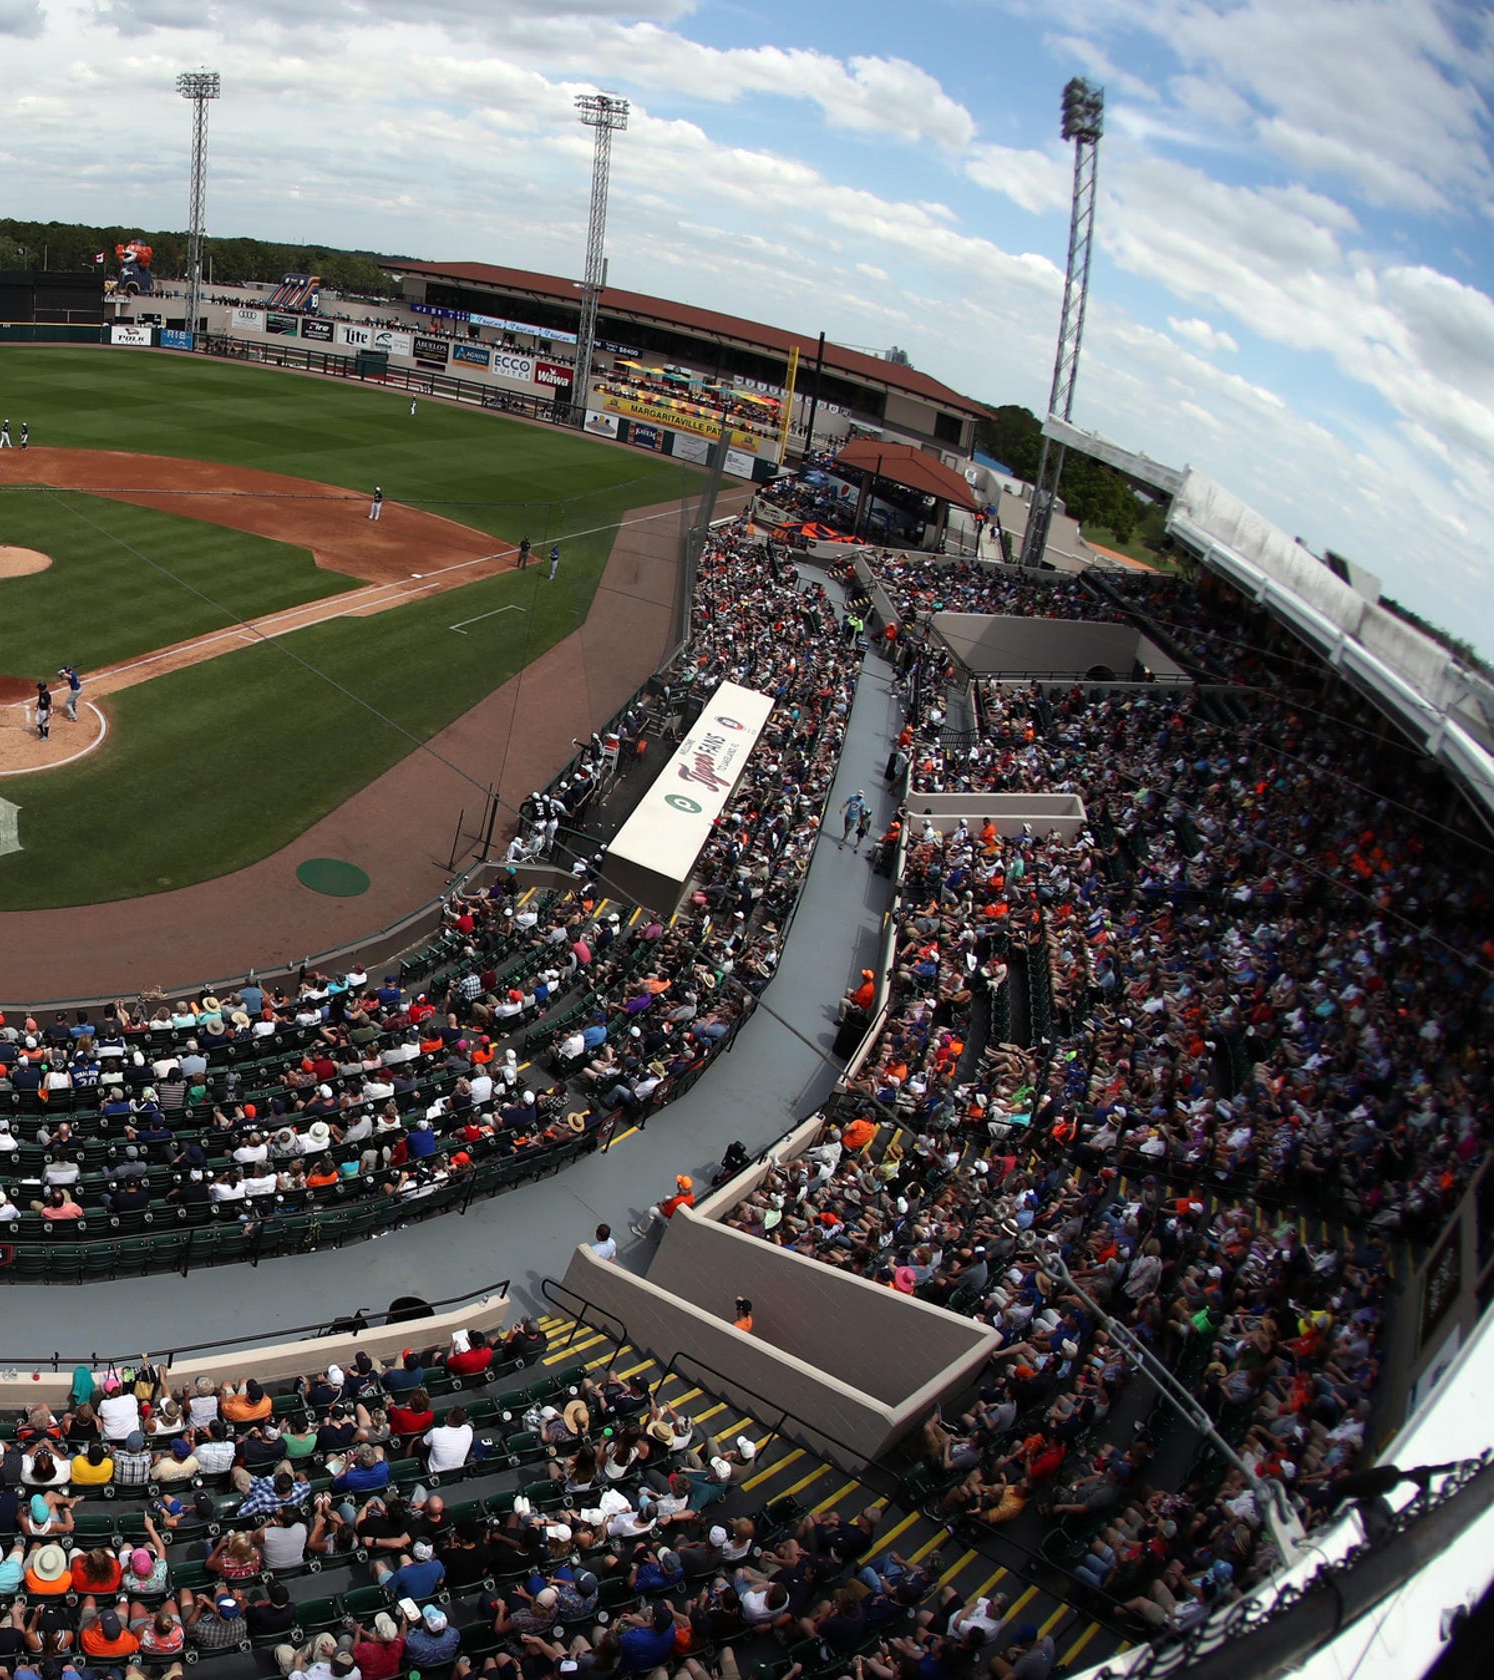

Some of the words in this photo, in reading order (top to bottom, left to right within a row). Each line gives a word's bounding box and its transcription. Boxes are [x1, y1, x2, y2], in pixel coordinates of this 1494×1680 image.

[346, 328, 368, 345] Lite
[494, 354, 531, 372] ECCO
[494, 367, 529, 380] SUITES
[537, 369, 570, 387] Wawa
[631, 405, 704, 431] MARGARITAVILLE
[698, 732, 726, 757] FANS
[678, 752, 731, 792] Tigers
